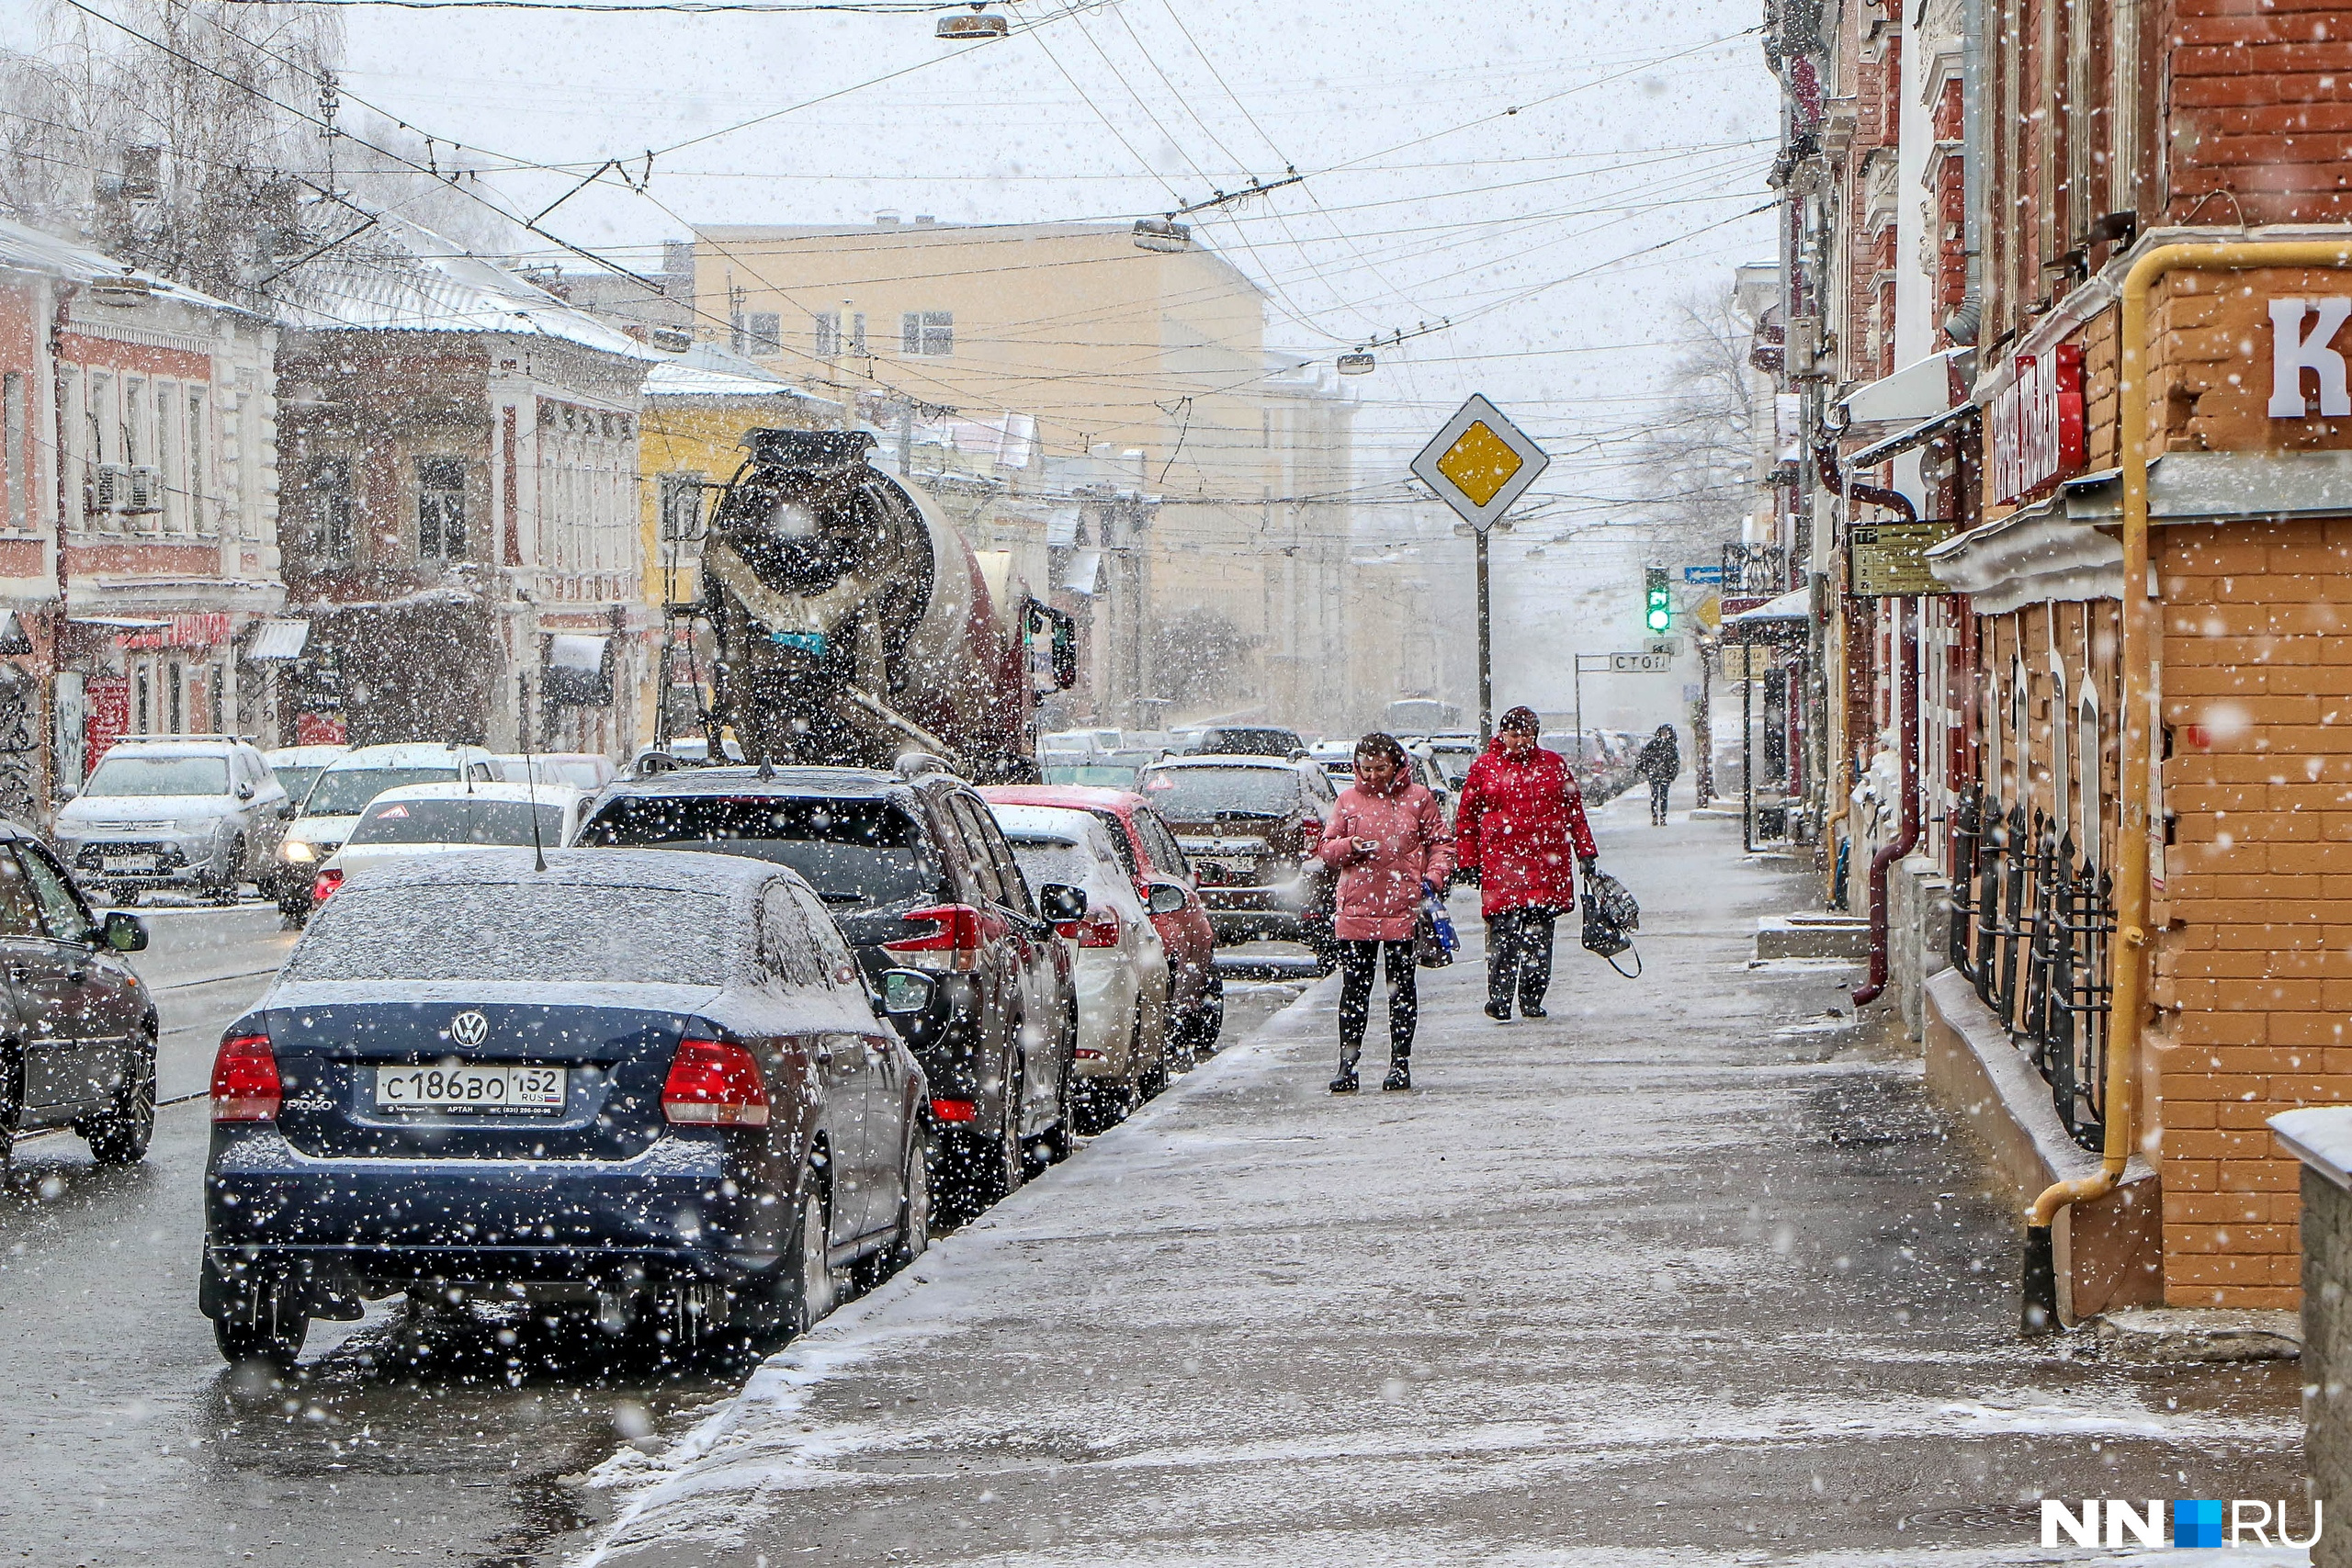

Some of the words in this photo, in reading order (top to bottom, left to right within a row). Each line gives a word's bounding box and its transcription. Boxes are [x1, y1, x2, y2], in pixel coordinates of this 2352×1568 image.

[1861, 569, 1868, 577] 2
[1615, 656, 1666, 669] СТОП
[386, 1070, 504, 1100] С186ВО
[512, 1070, 557, 1093] 152
[521, 1093, 544, 1101] RUS
[286, 1099, 333, 1111] POLO
